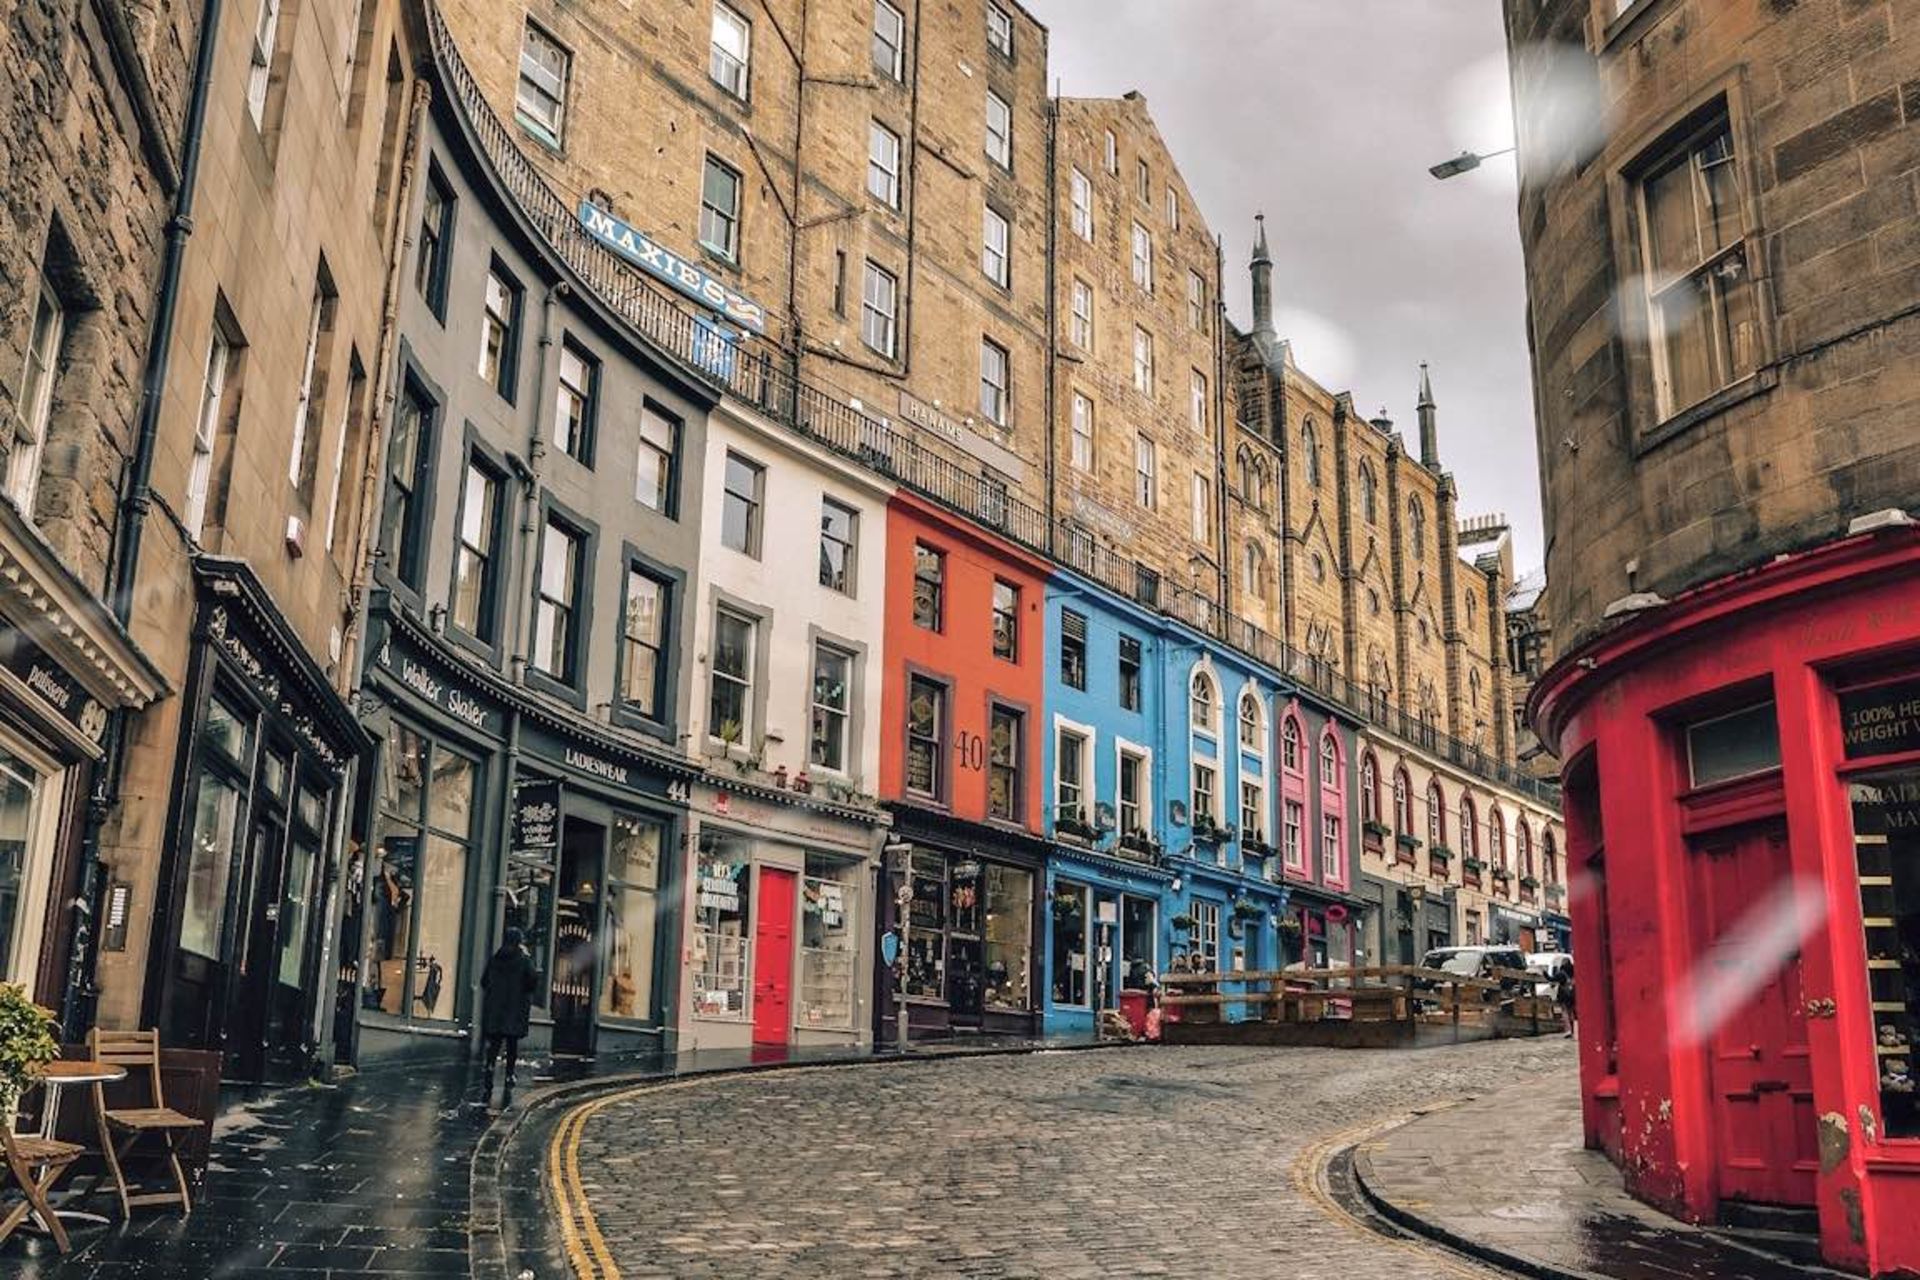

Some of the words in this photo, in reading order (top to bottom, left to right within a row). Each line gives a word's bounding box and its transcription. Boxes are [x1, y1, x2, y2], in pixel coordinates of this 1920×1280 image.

[587, 209, 726, 306] MAXIES
[402, 658, 442, 701] Walker
[448, 690, 488, 726] Slater
[1844, 719, 1908, 745] WEIGHT
[1851, 705, 1895, 727] 100%
[565, 748, 628, 784] LADIESWEAR
